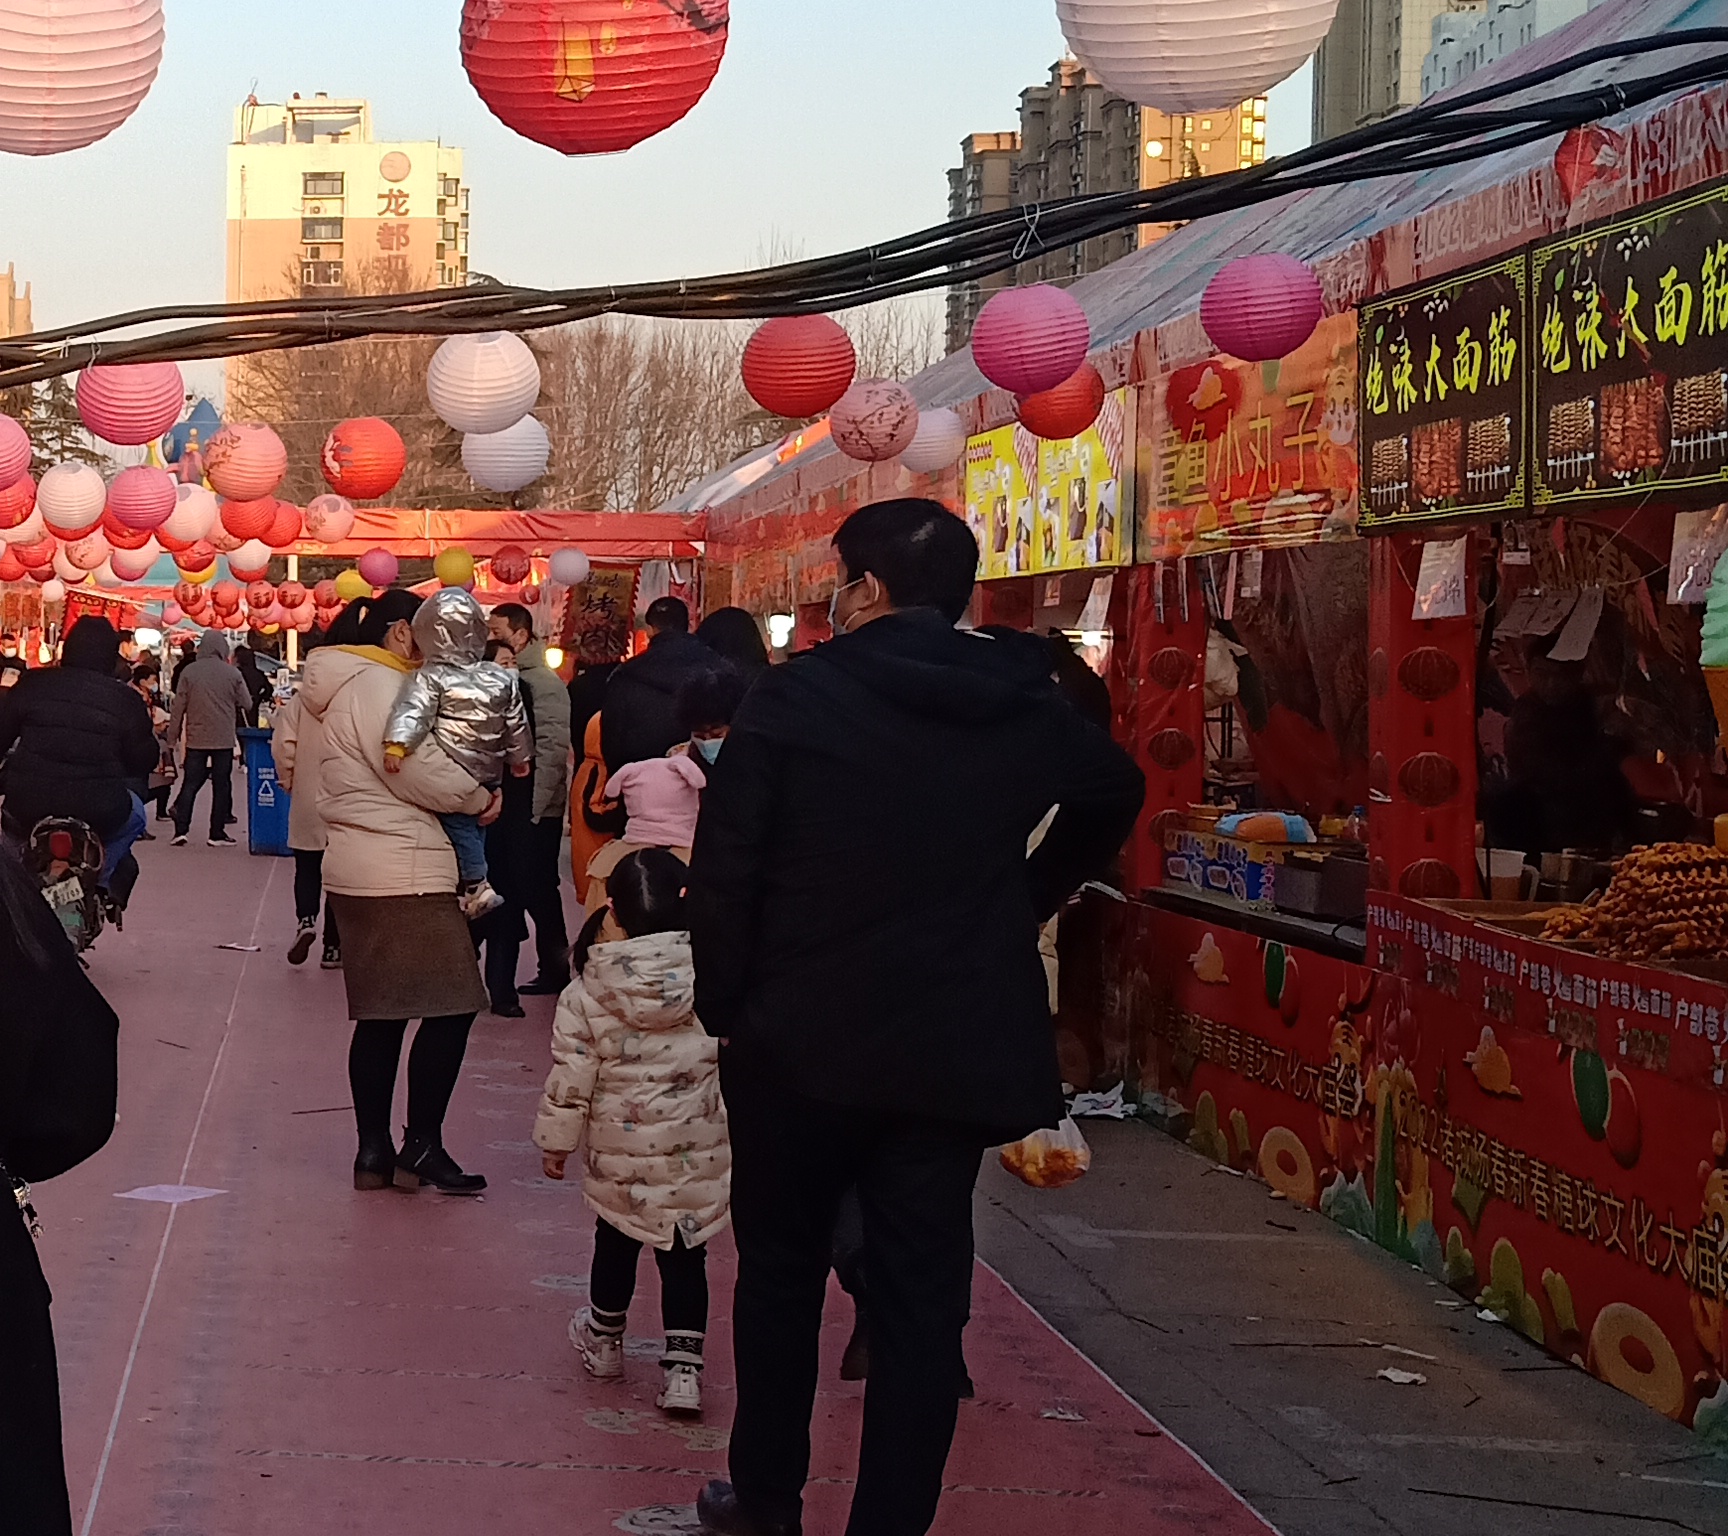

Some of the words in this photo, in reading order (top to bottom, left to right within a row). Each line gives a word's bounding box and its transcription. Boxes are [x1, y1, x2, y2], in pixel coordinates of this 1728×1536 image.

[1365, 303, 1517, 415] 绝味大面筋
[1541, 239, 1728, 375] 绝味大面筋
[1158, 393, 1319, 506] 章鱼小丸子
